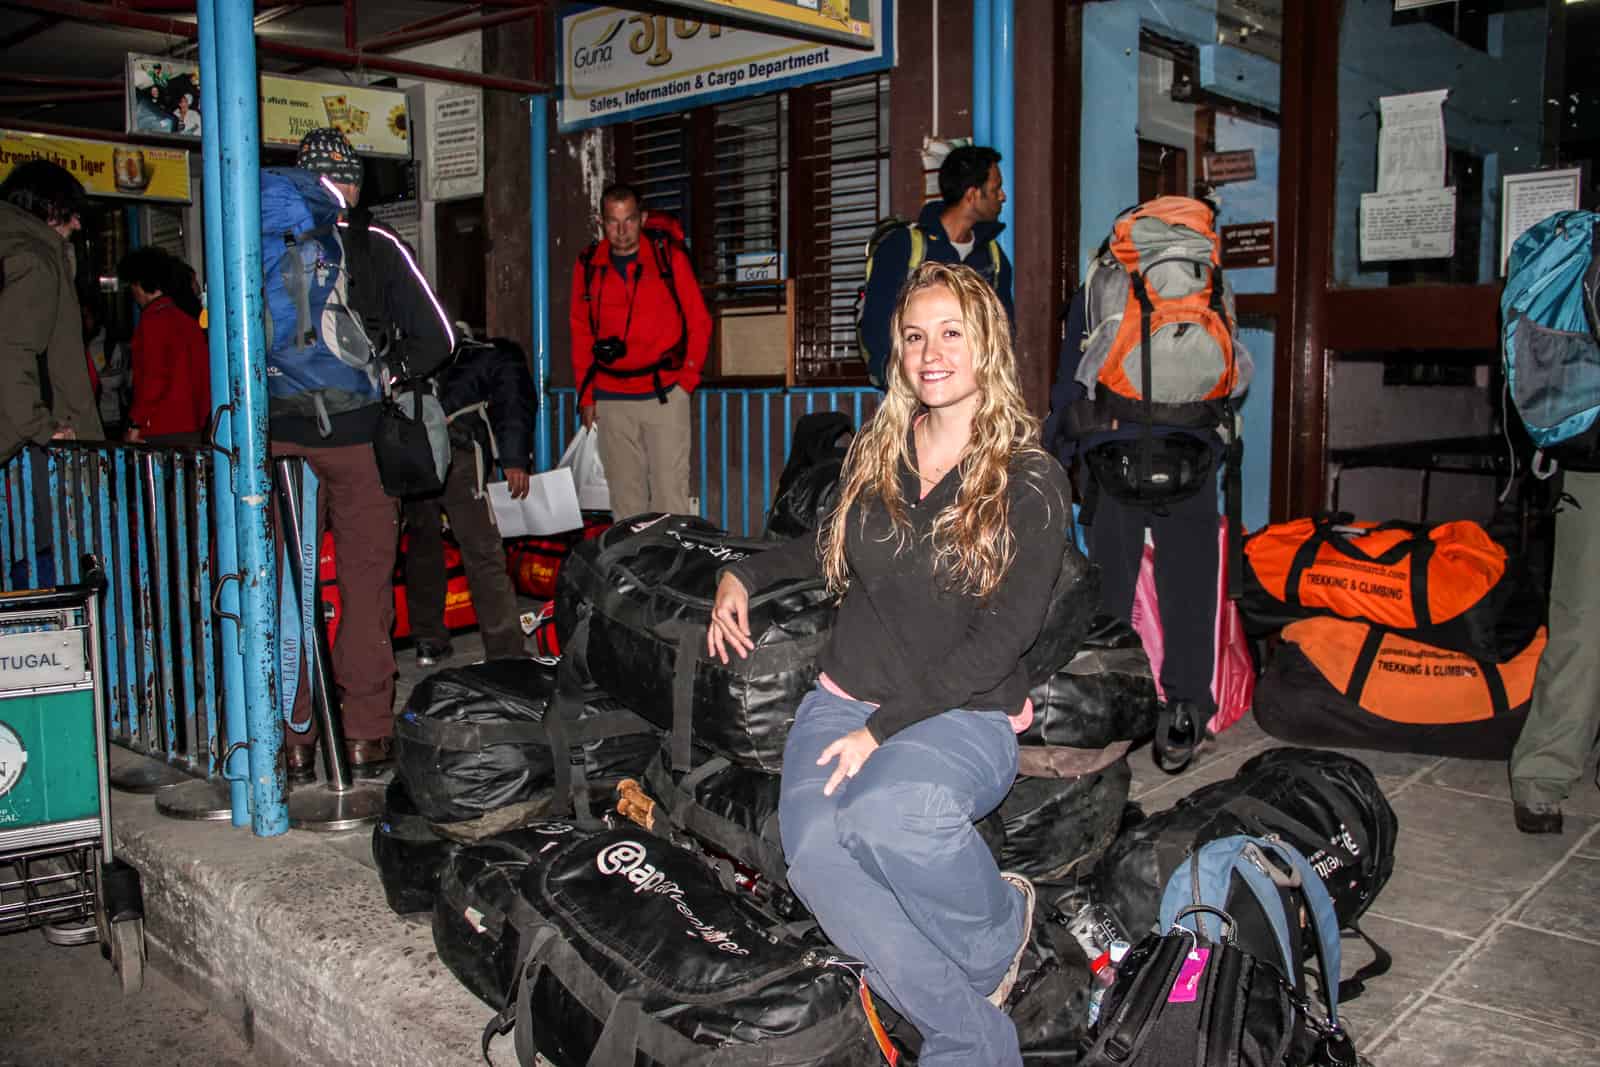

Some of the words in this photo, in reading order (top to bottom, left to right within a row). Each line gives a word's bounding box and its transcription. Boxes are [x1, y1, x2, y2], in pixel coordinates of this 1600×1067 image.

[574, 46, 612, 68] Guna
[589, 96, 622, 113] Sales,
[625, 80, 691, 105] Information
[694, 75, 704, 89] &
[708, 69, 745, 86] Cargo
[749, 48, 830, 77] Department
[1306, 573, 1348, 590] TREKKING
[1349, 579, 1357, 590] &
[1359, 581, 1404, 600] CLIMBING
[1377, 660, 1421, 675] TREKKING
